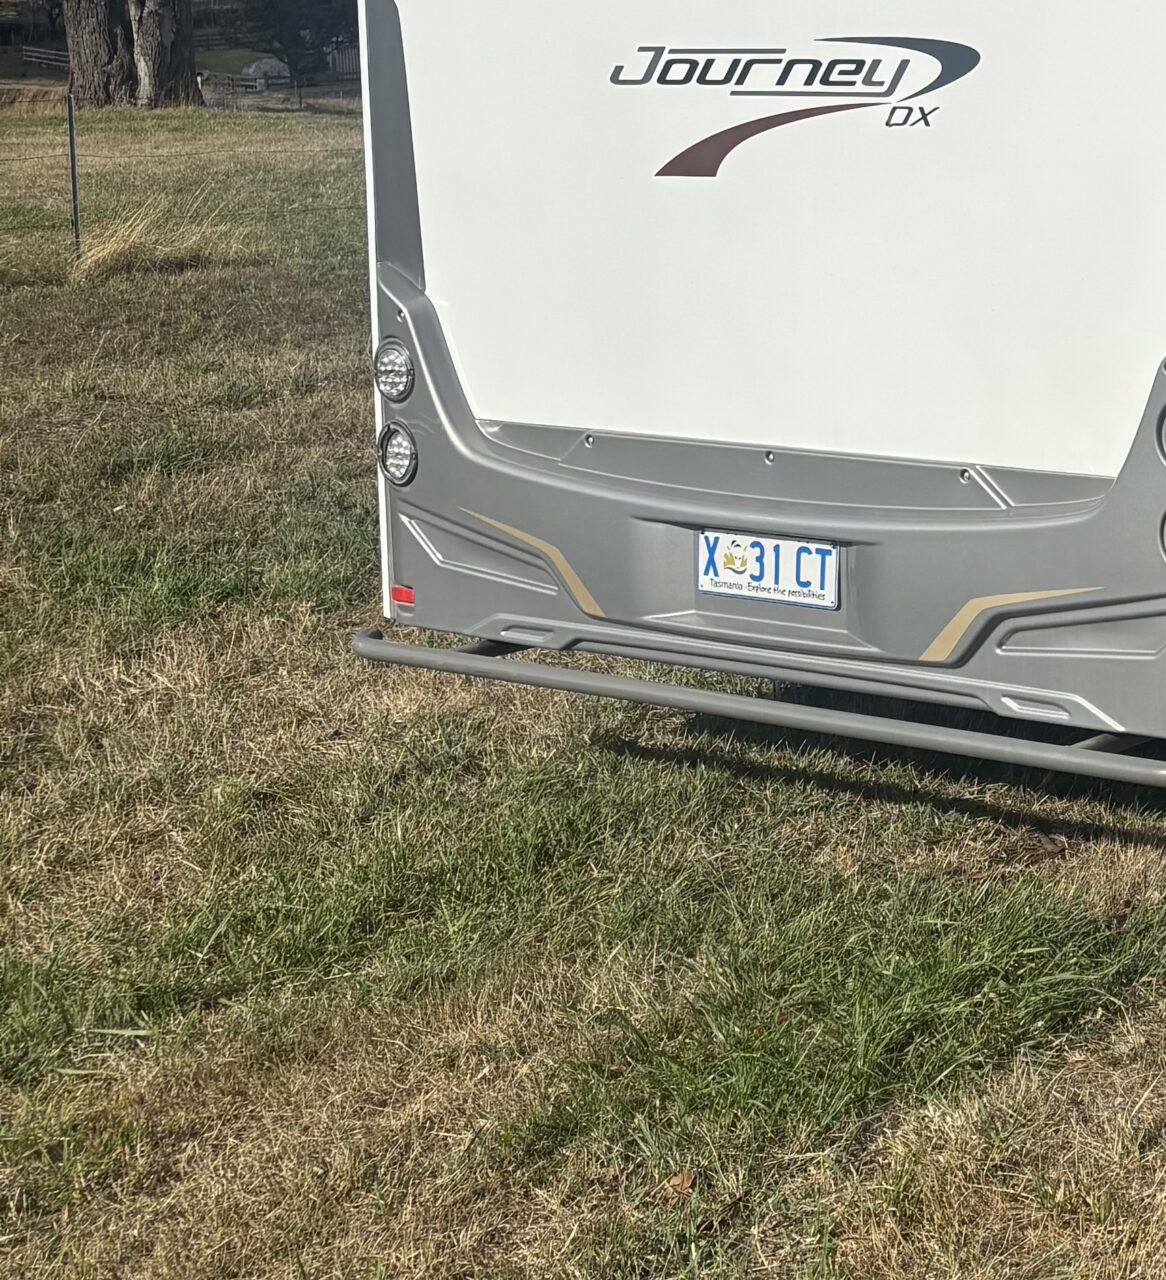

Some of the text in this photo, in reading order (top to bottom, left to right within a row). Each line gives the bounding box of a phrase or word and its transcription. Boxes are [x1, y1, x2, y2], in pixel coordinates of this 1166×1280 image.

[609, 45, 911, 98] Journey
[884, 105, 941, 128] DX
[703, 535, 720, 577] X
[795, 545, 833, 591] CT
[709, 577, 743, 590] Tasmania
[747, 582, 772, 594] Explore
[773, 585, 786, 596] the
[787, 588, 826, 601] possibilities
